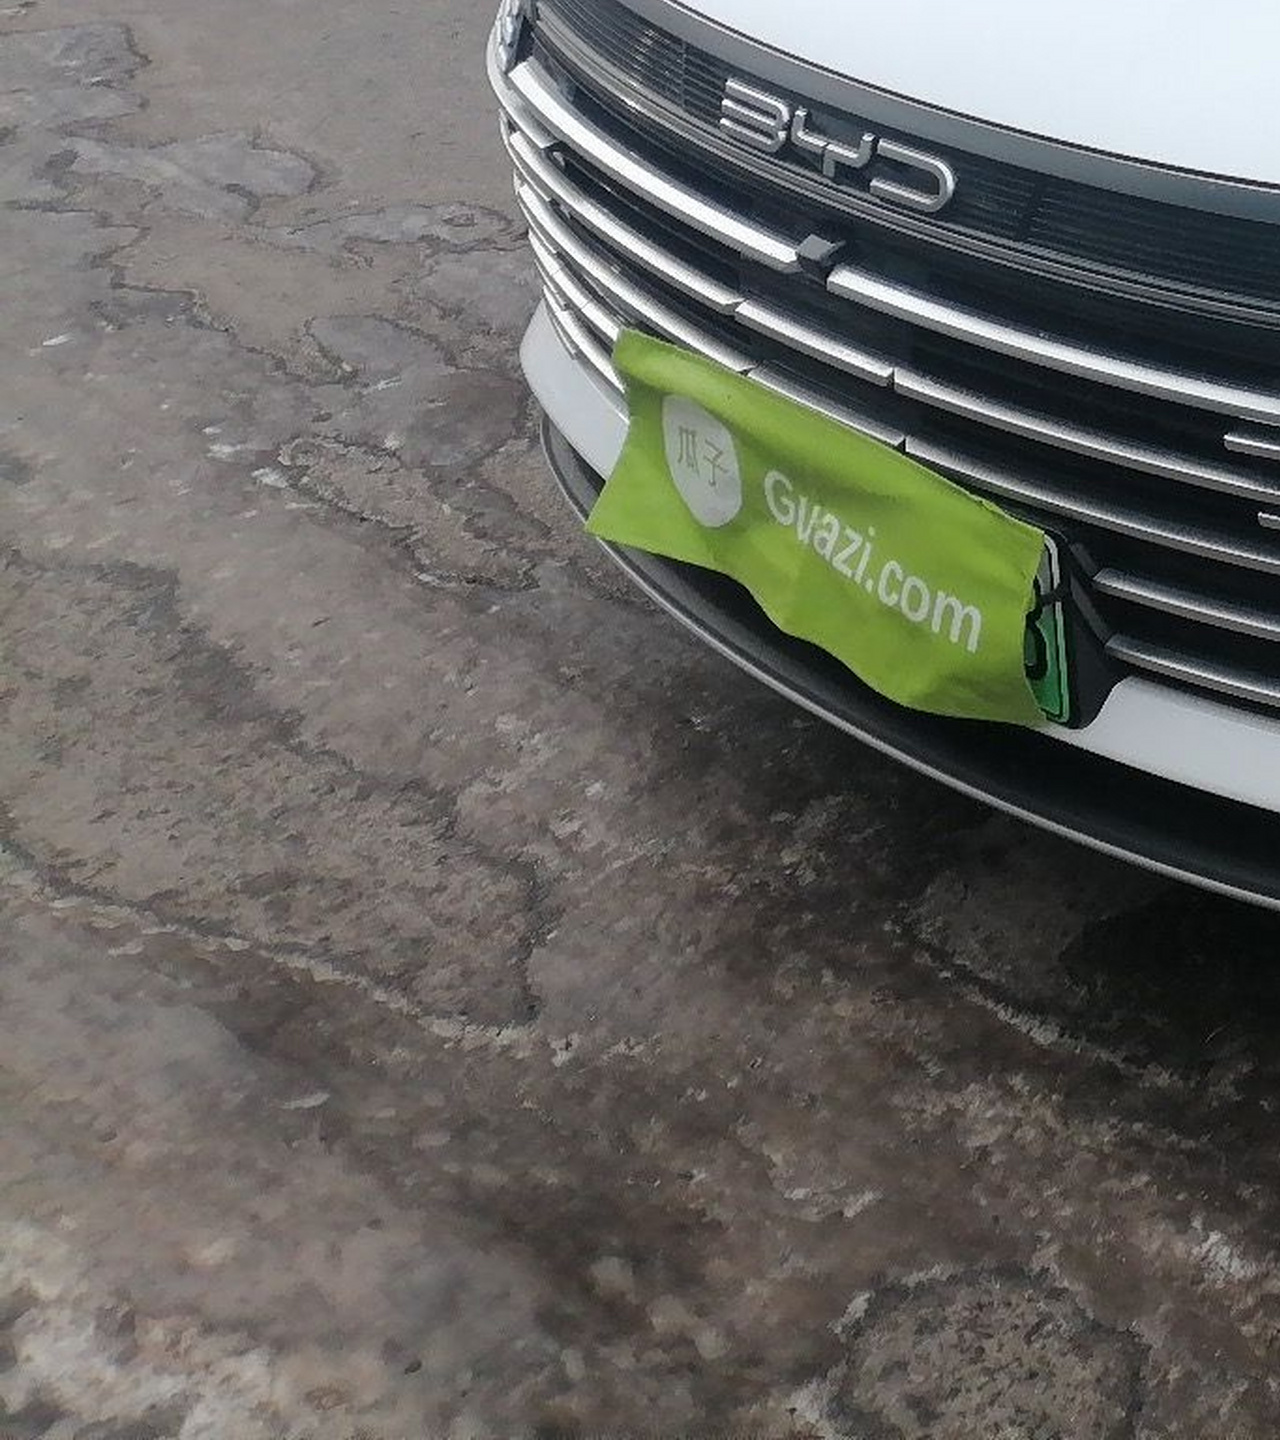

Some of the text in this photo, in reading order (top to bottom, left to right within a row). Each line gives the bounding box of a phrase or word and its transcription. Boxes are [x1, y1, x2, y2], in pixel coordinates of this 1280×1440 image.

[720, 76, 957, 212] BYD
[676, 426, 729, 488] 瓜子
[763, 469, 983, 654] Guazi.com
